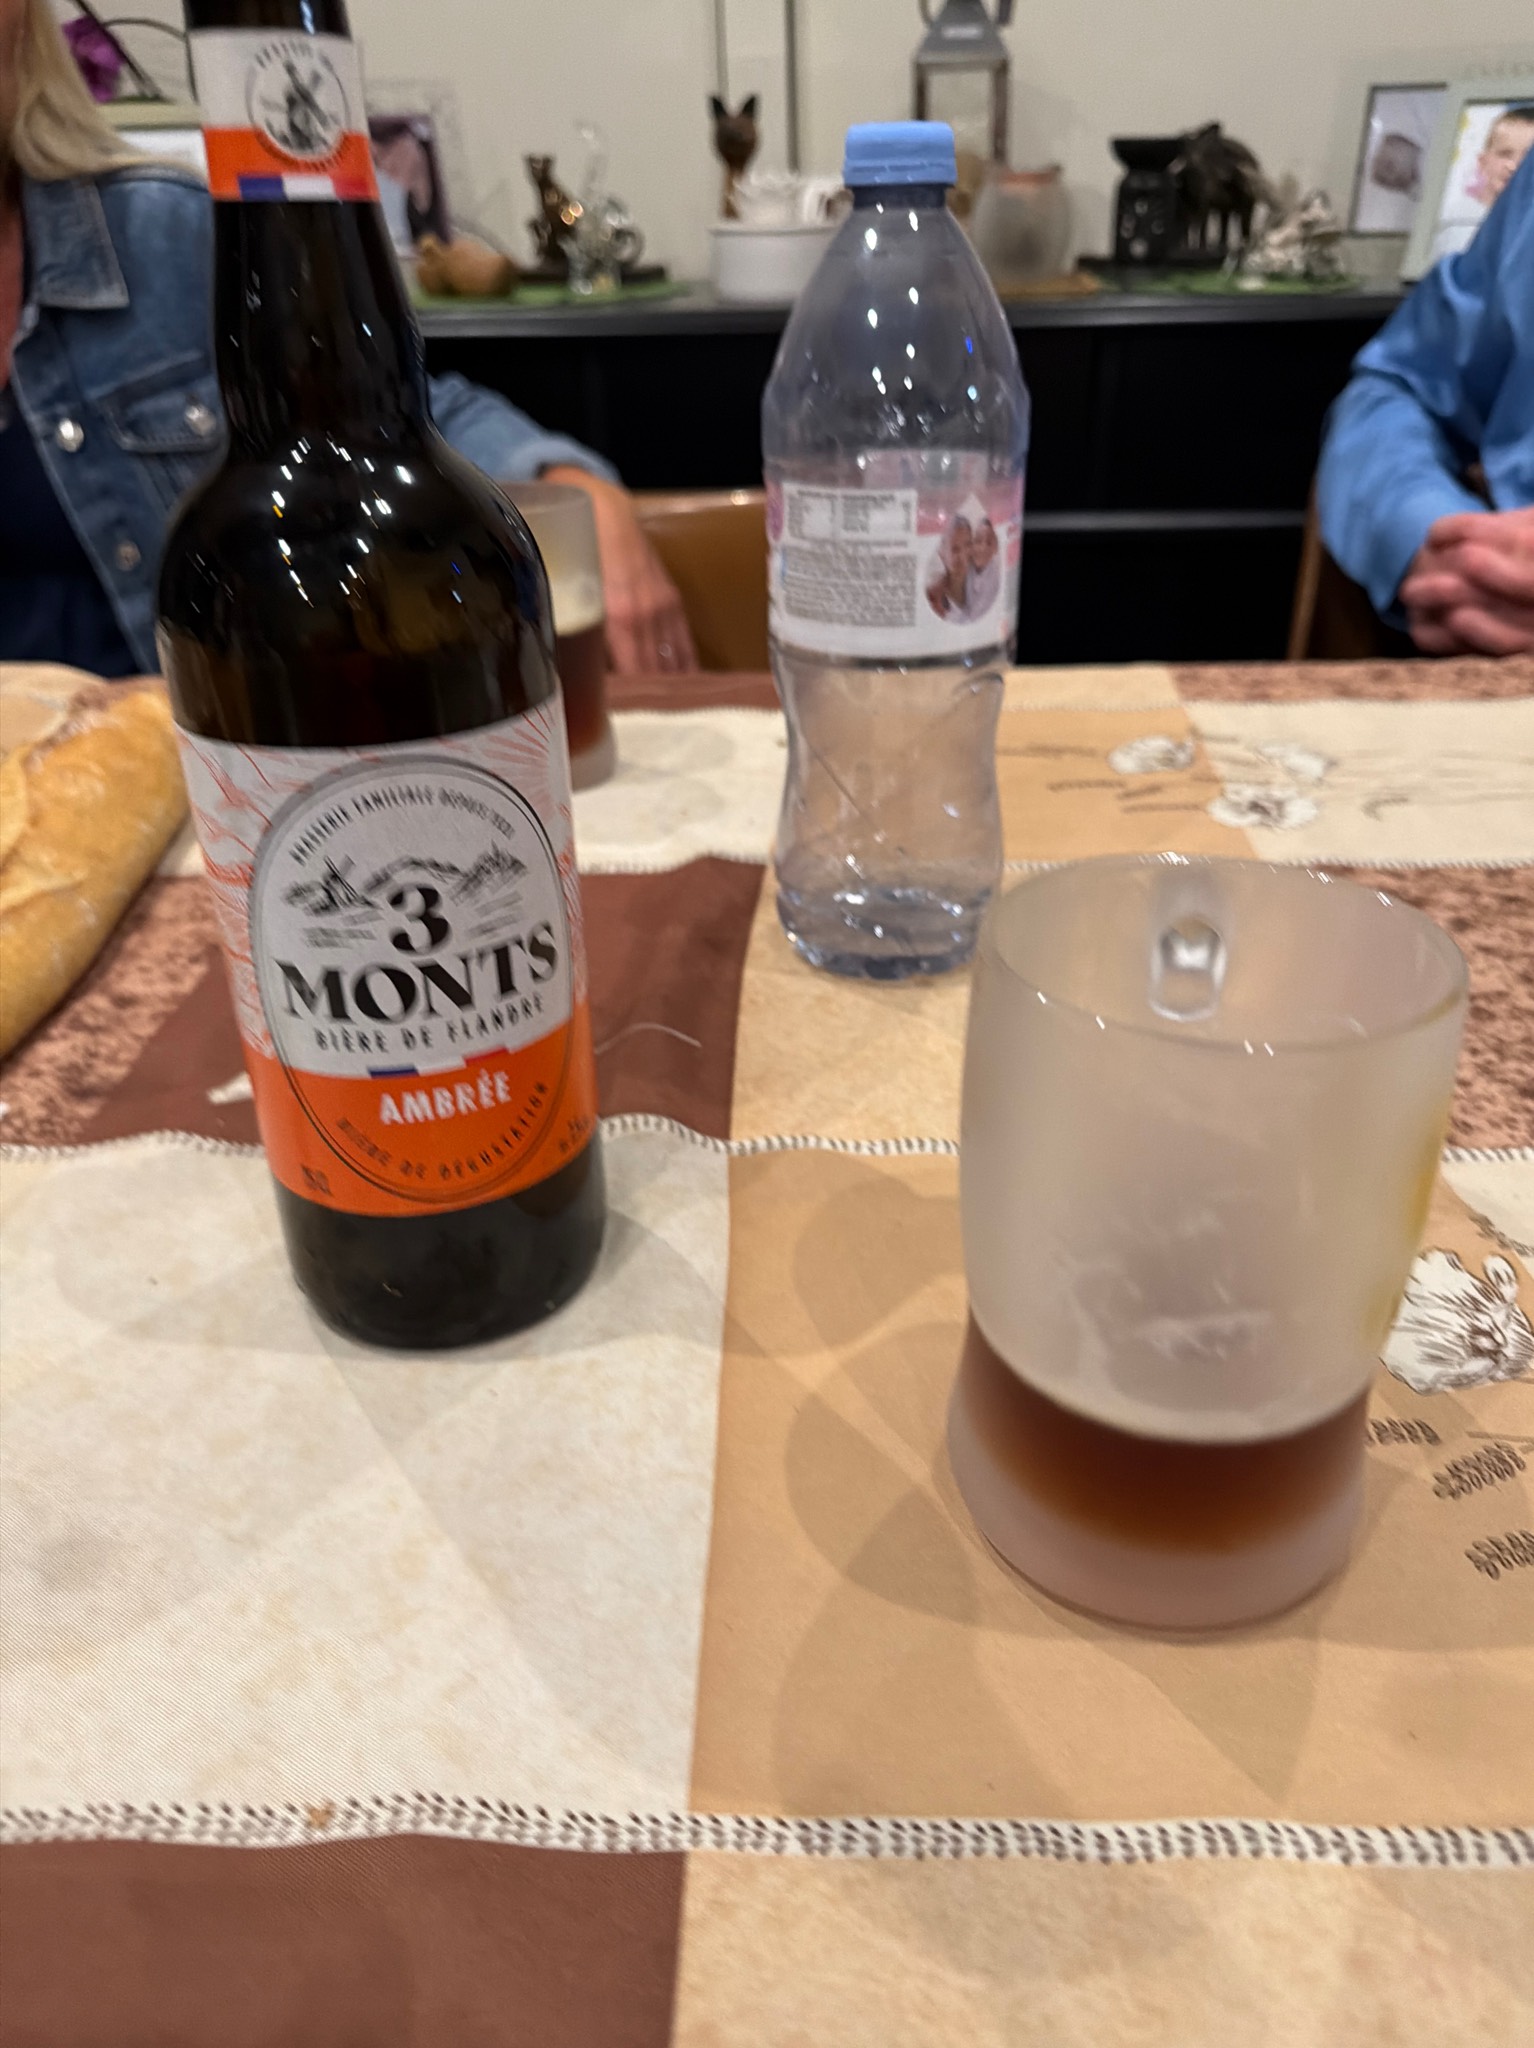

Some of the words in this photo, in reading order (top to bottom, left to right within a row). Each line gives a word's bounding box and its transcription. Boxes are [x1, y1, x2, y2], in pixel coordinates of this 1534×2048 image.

[388, 883, 451, 954] 3
[273, 921, 558, 1025] MONTS
[402, 1025, 433, 1049] DE
[447, 992, 543, 1043] FLANDRE
[380, 1069, 512, 1126] AMBRÉE
